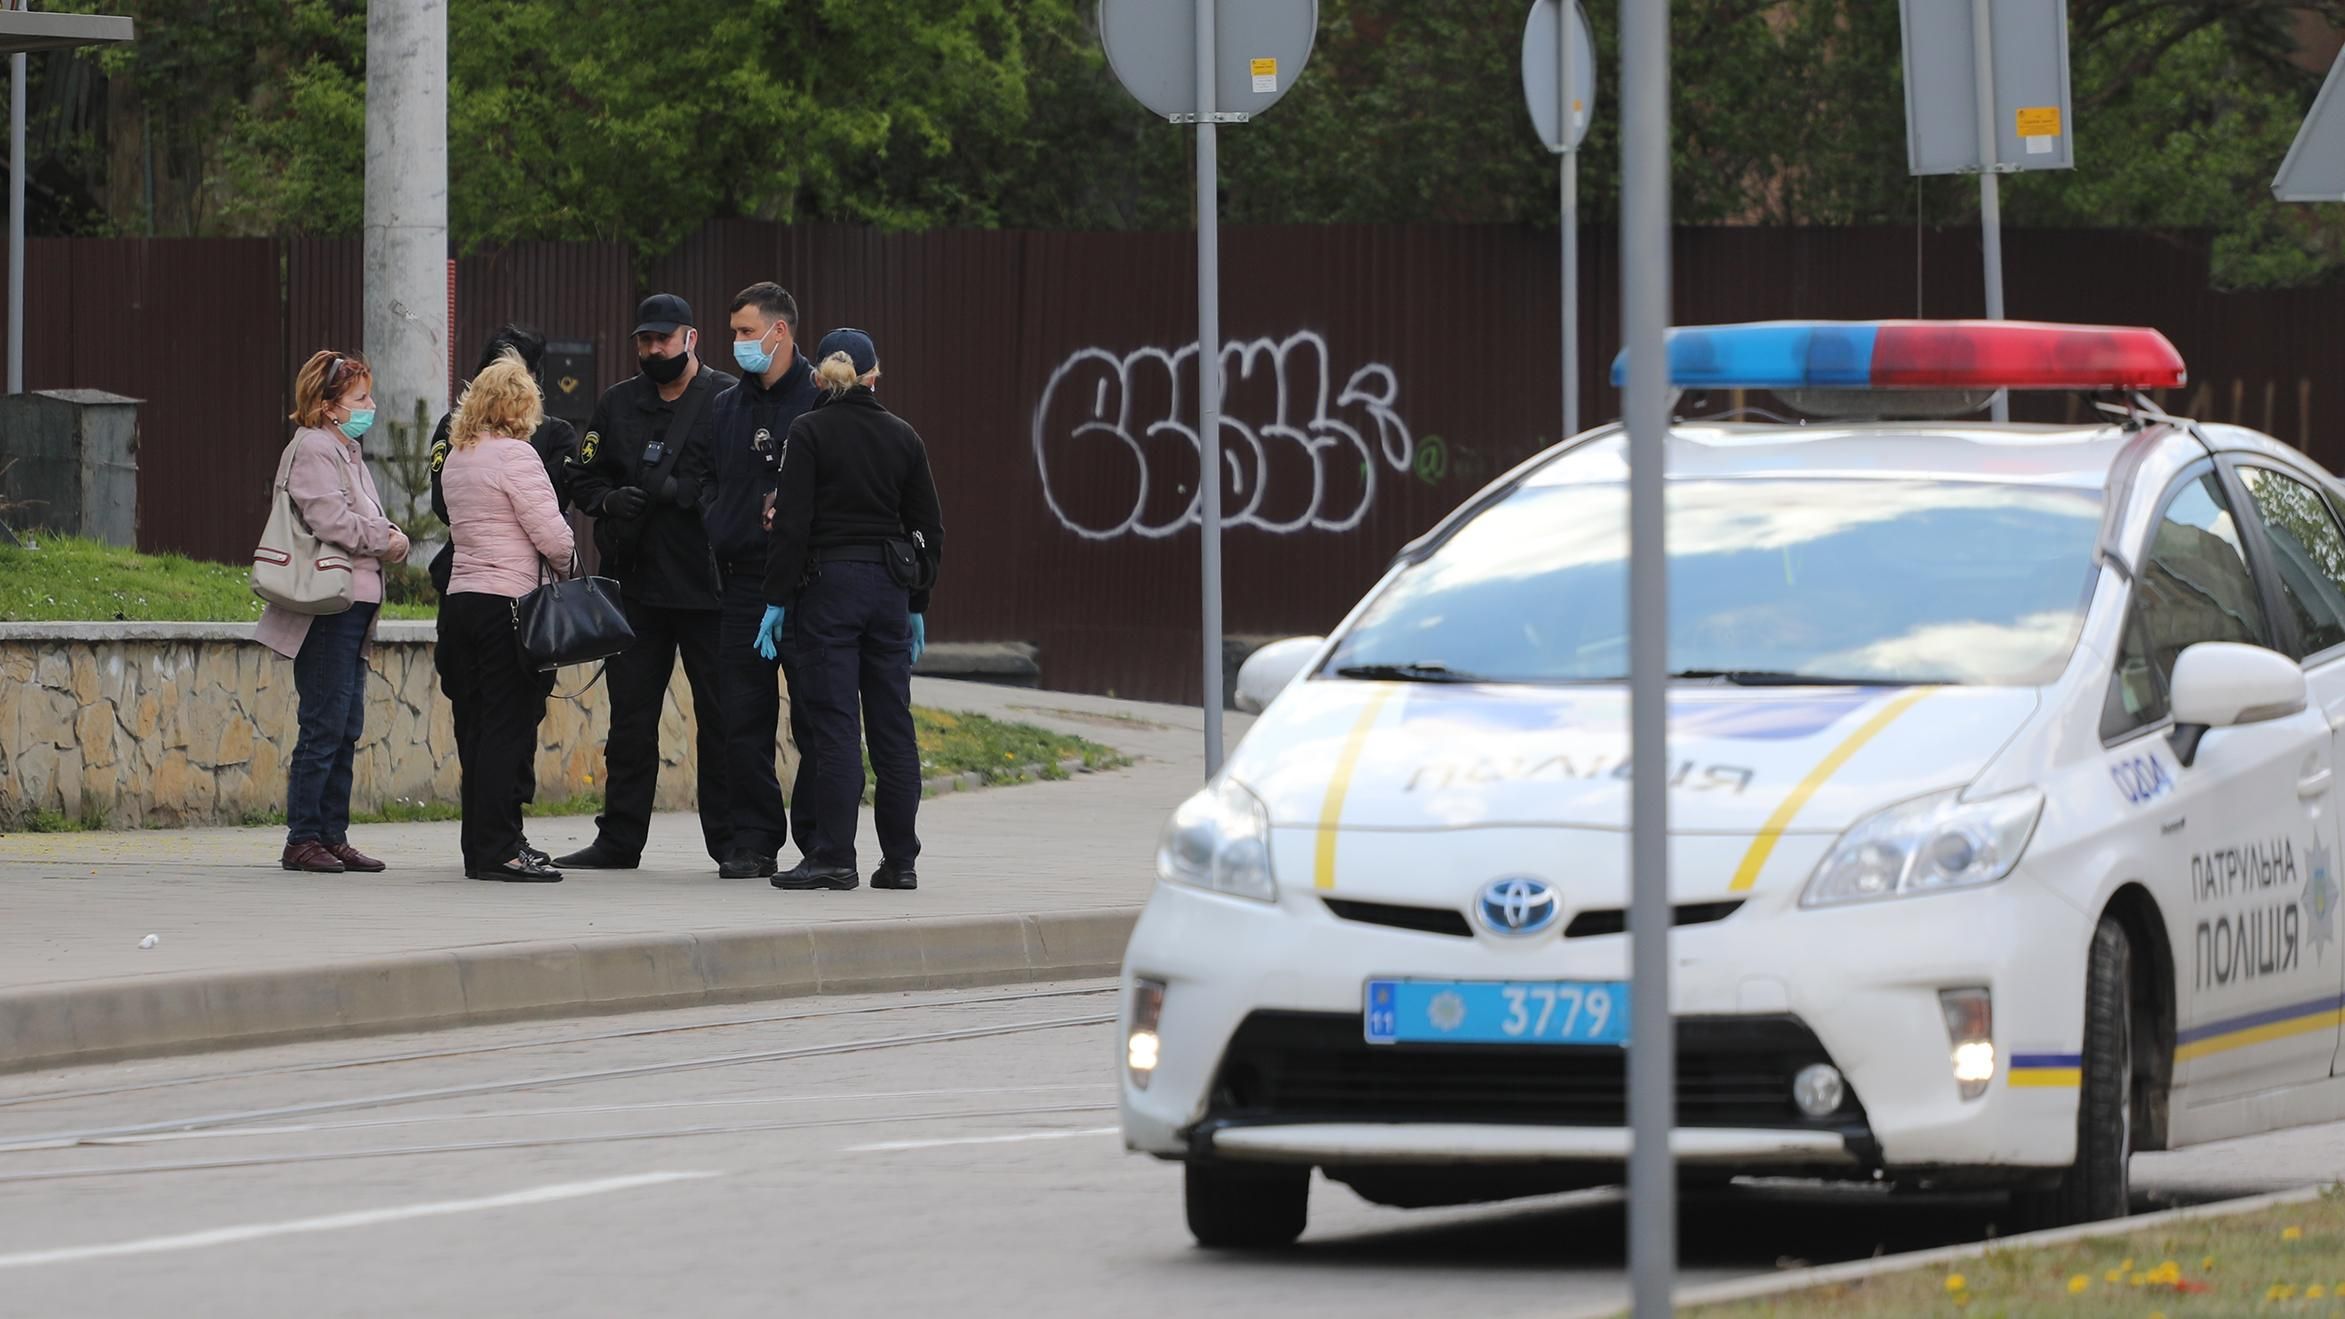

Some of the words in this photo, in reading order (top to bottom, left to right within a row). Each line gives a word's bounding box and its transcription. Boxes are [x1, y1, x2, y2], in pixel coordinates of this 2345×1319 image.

[2191, 835, 2297, 902] ПАТРУЛЬНА
[2195, 903, 2299, 991] ПОЛІЦІЯ
[1372, 1011, 1394, 1034] 11
[1501, 987, 1612, 1037] 3779
